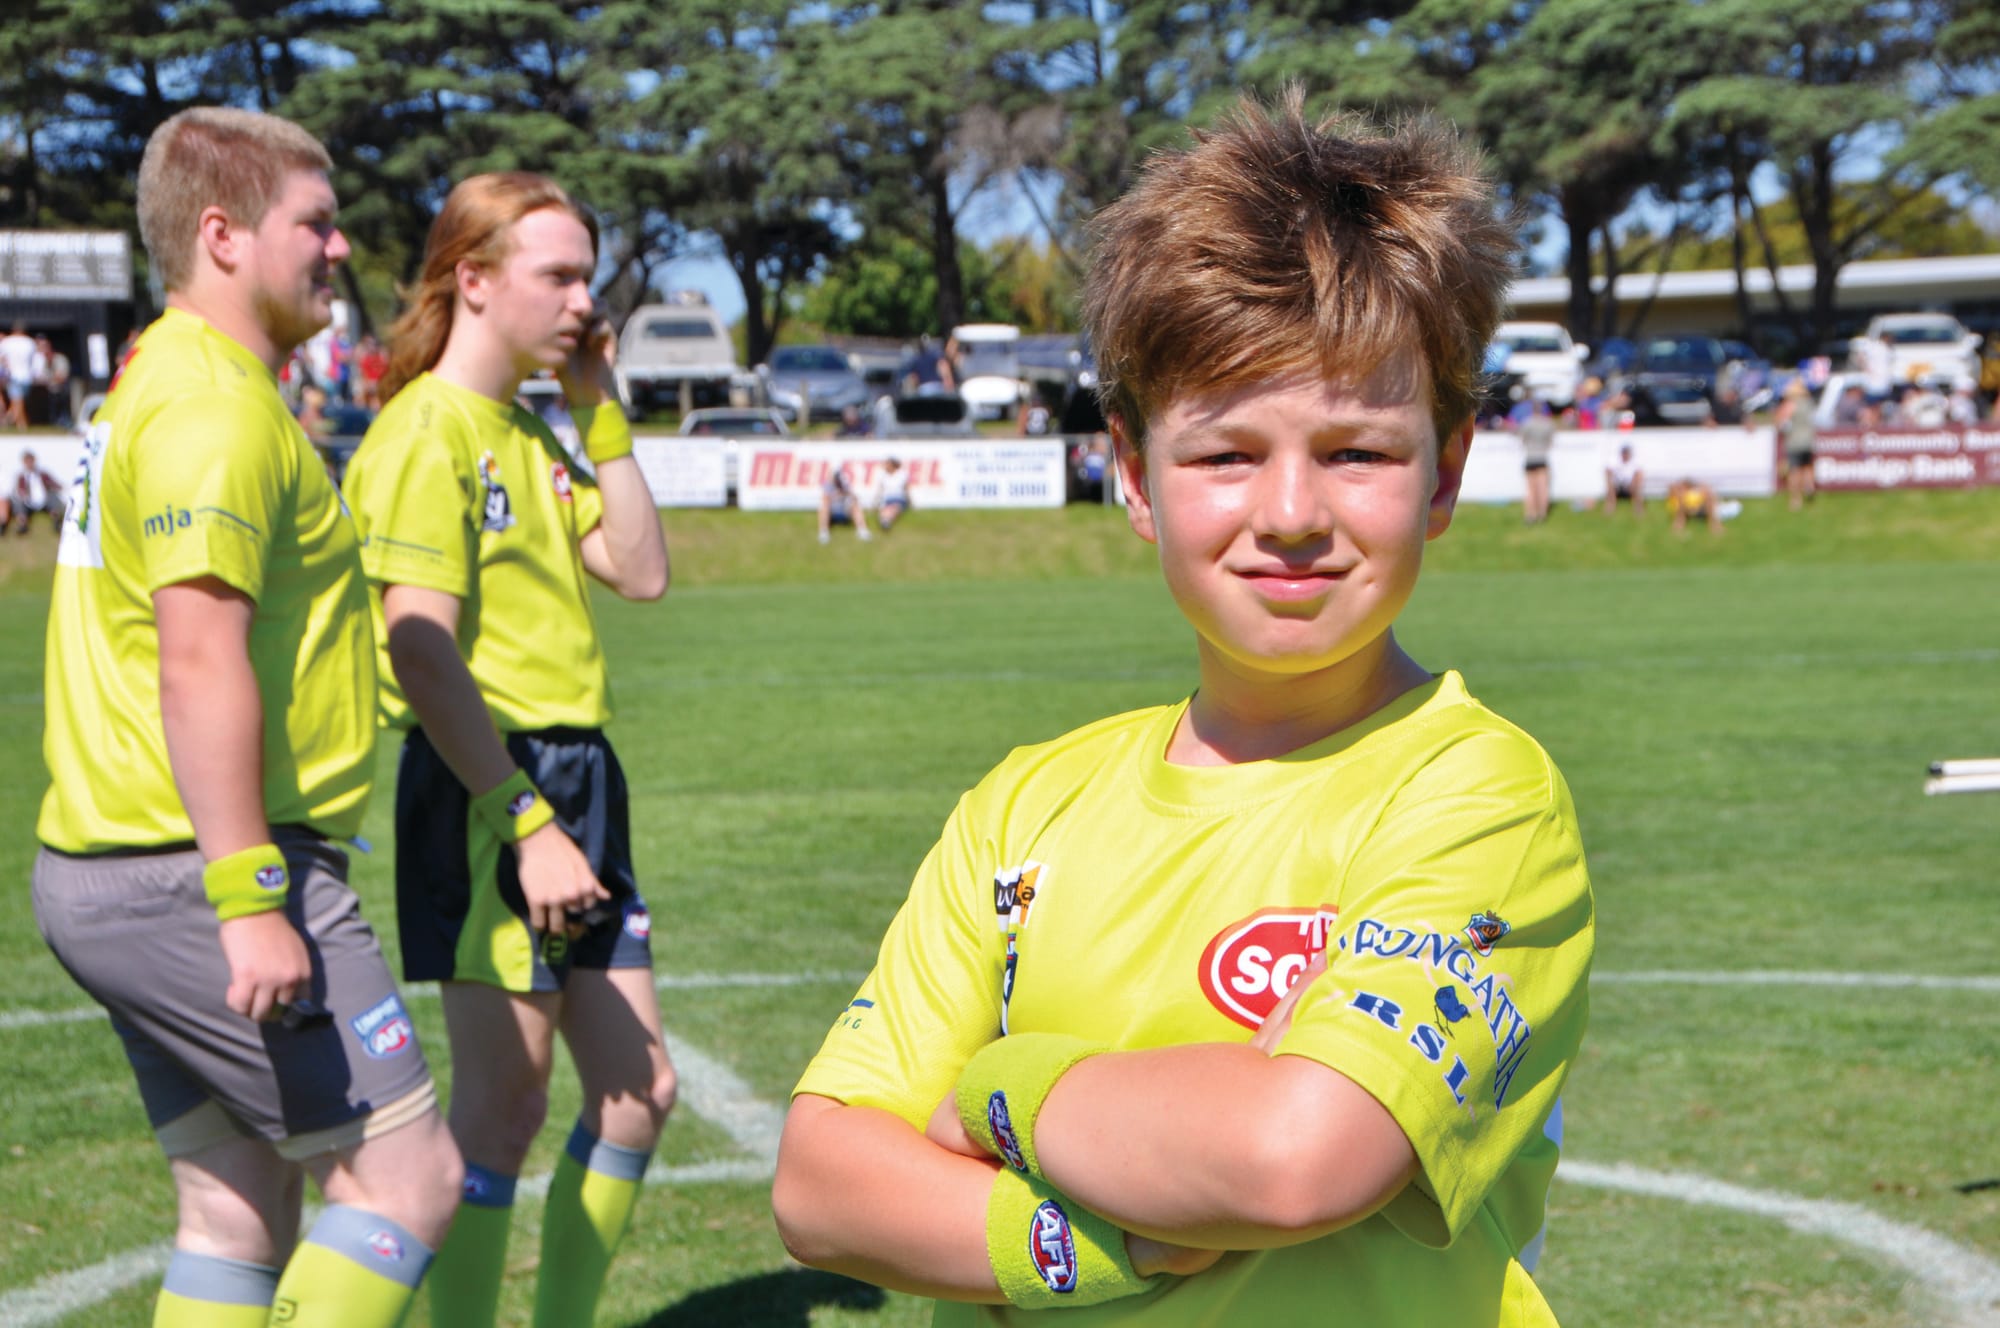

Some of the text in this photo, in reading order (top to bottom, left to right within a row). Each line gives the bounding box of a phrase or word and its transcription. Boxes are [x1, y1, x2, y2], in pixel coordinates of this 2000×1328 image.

[1911, 454, 1975, 481] Bank
[144, 504, 192, 538] mja
[1339, 919, 1531, 1113] EONGATHA
[1037, 1206, 1071, 1290] AFL
